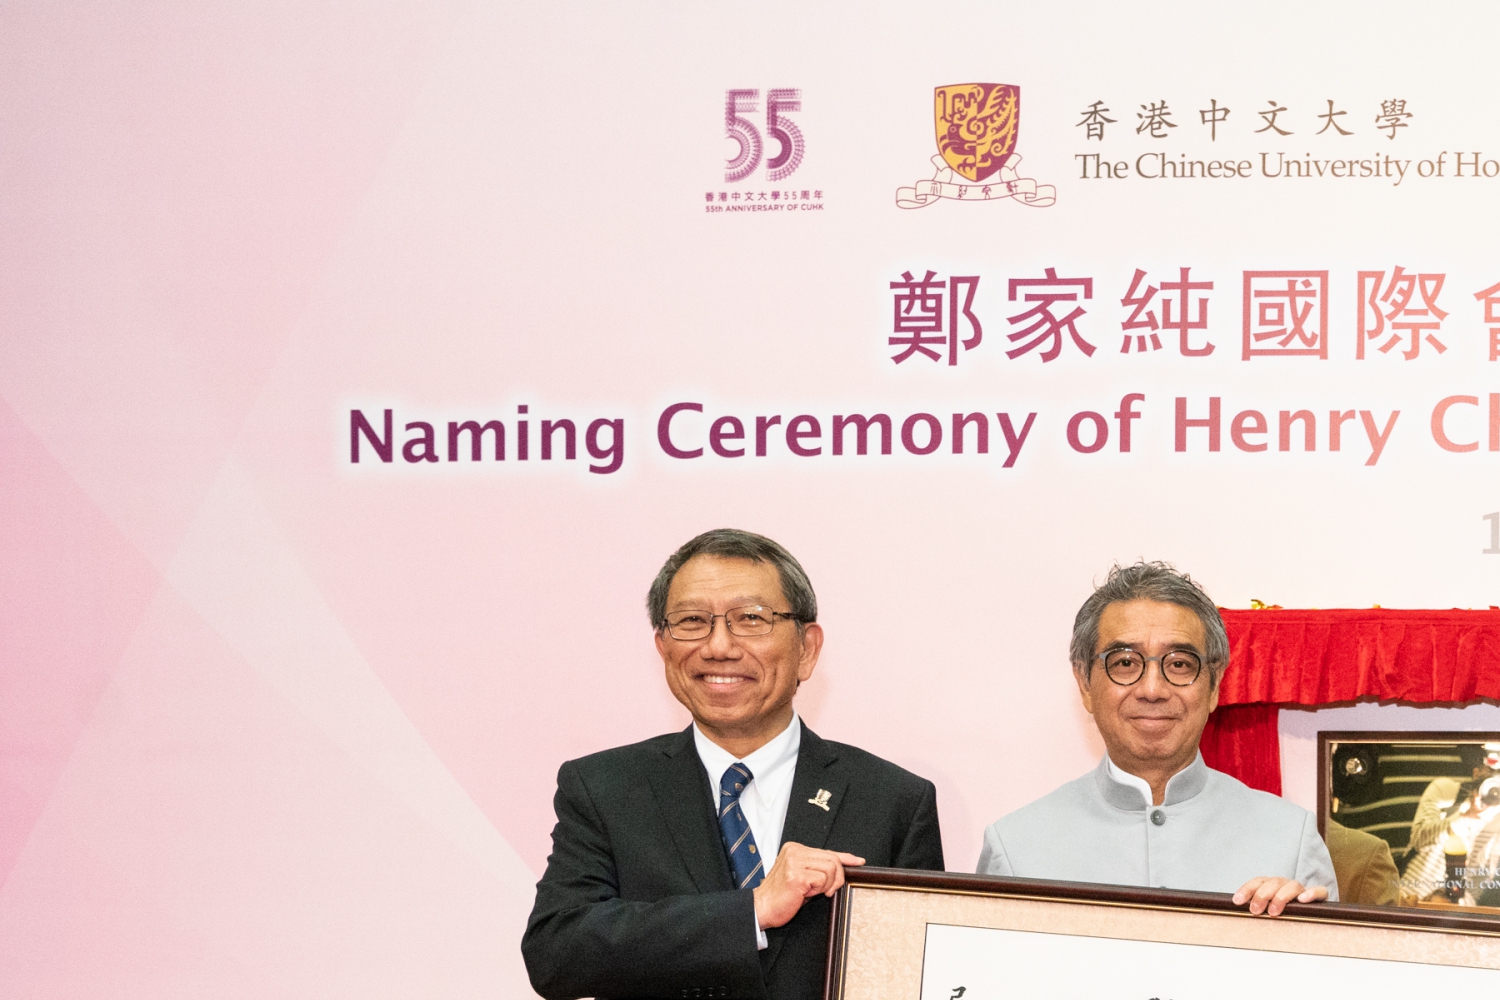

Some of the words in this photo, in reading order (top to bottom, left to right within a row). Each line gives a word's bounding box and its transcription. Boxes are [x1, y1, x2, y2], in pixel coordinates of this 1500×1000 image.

[724, 88, 806, 183] 55
[1075, 97, 1414, 142] 香港中文大學
[1074, 152, 1129, 180] The
[1135, 152, 1253, 180] Chinese
[1260, 152, 1412, 187] University
[1417, 151, 1448, 178] of
[705, 205, 723, 213] 55th
[725, 204, 785, 213] ANNIVERSARY
[786, 203, 799, 211] OF
[800, 203, 824, 211] CUHK
[349, 404, 626, 475] Naming
[656, 401, 1038, 469] Ceremony
[1066, 392, 1146, 454] of
[1174, 396, 1400, 466] Henry
